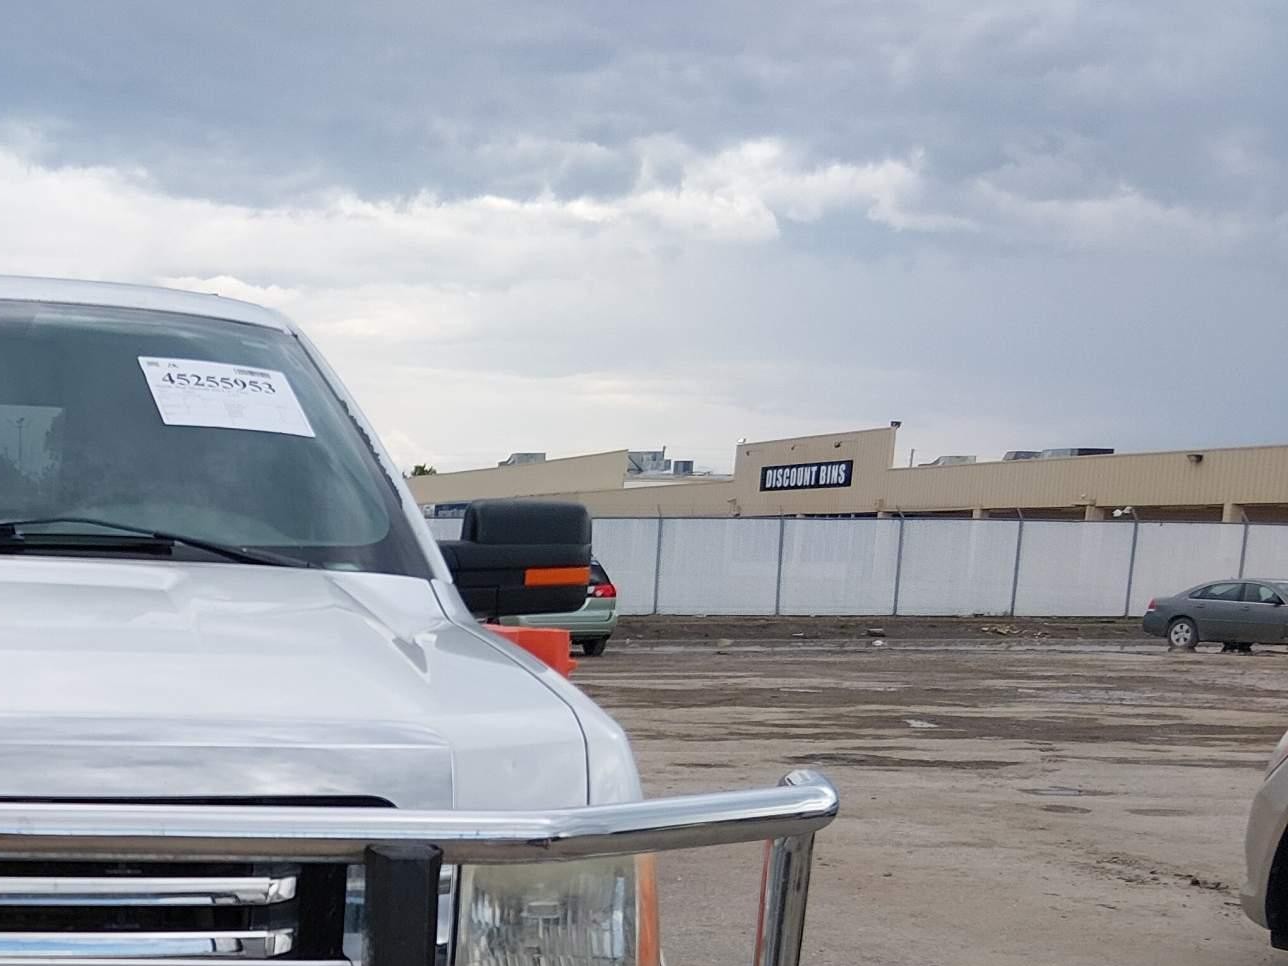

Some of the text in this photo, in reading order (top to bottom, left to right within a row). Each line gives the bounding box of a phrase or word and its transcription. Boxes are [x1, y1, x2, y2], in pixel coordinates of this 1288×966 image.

[161, 371, 277, 395] 45255953
[765, 463, 846, 489] DISCOUNT BINS
